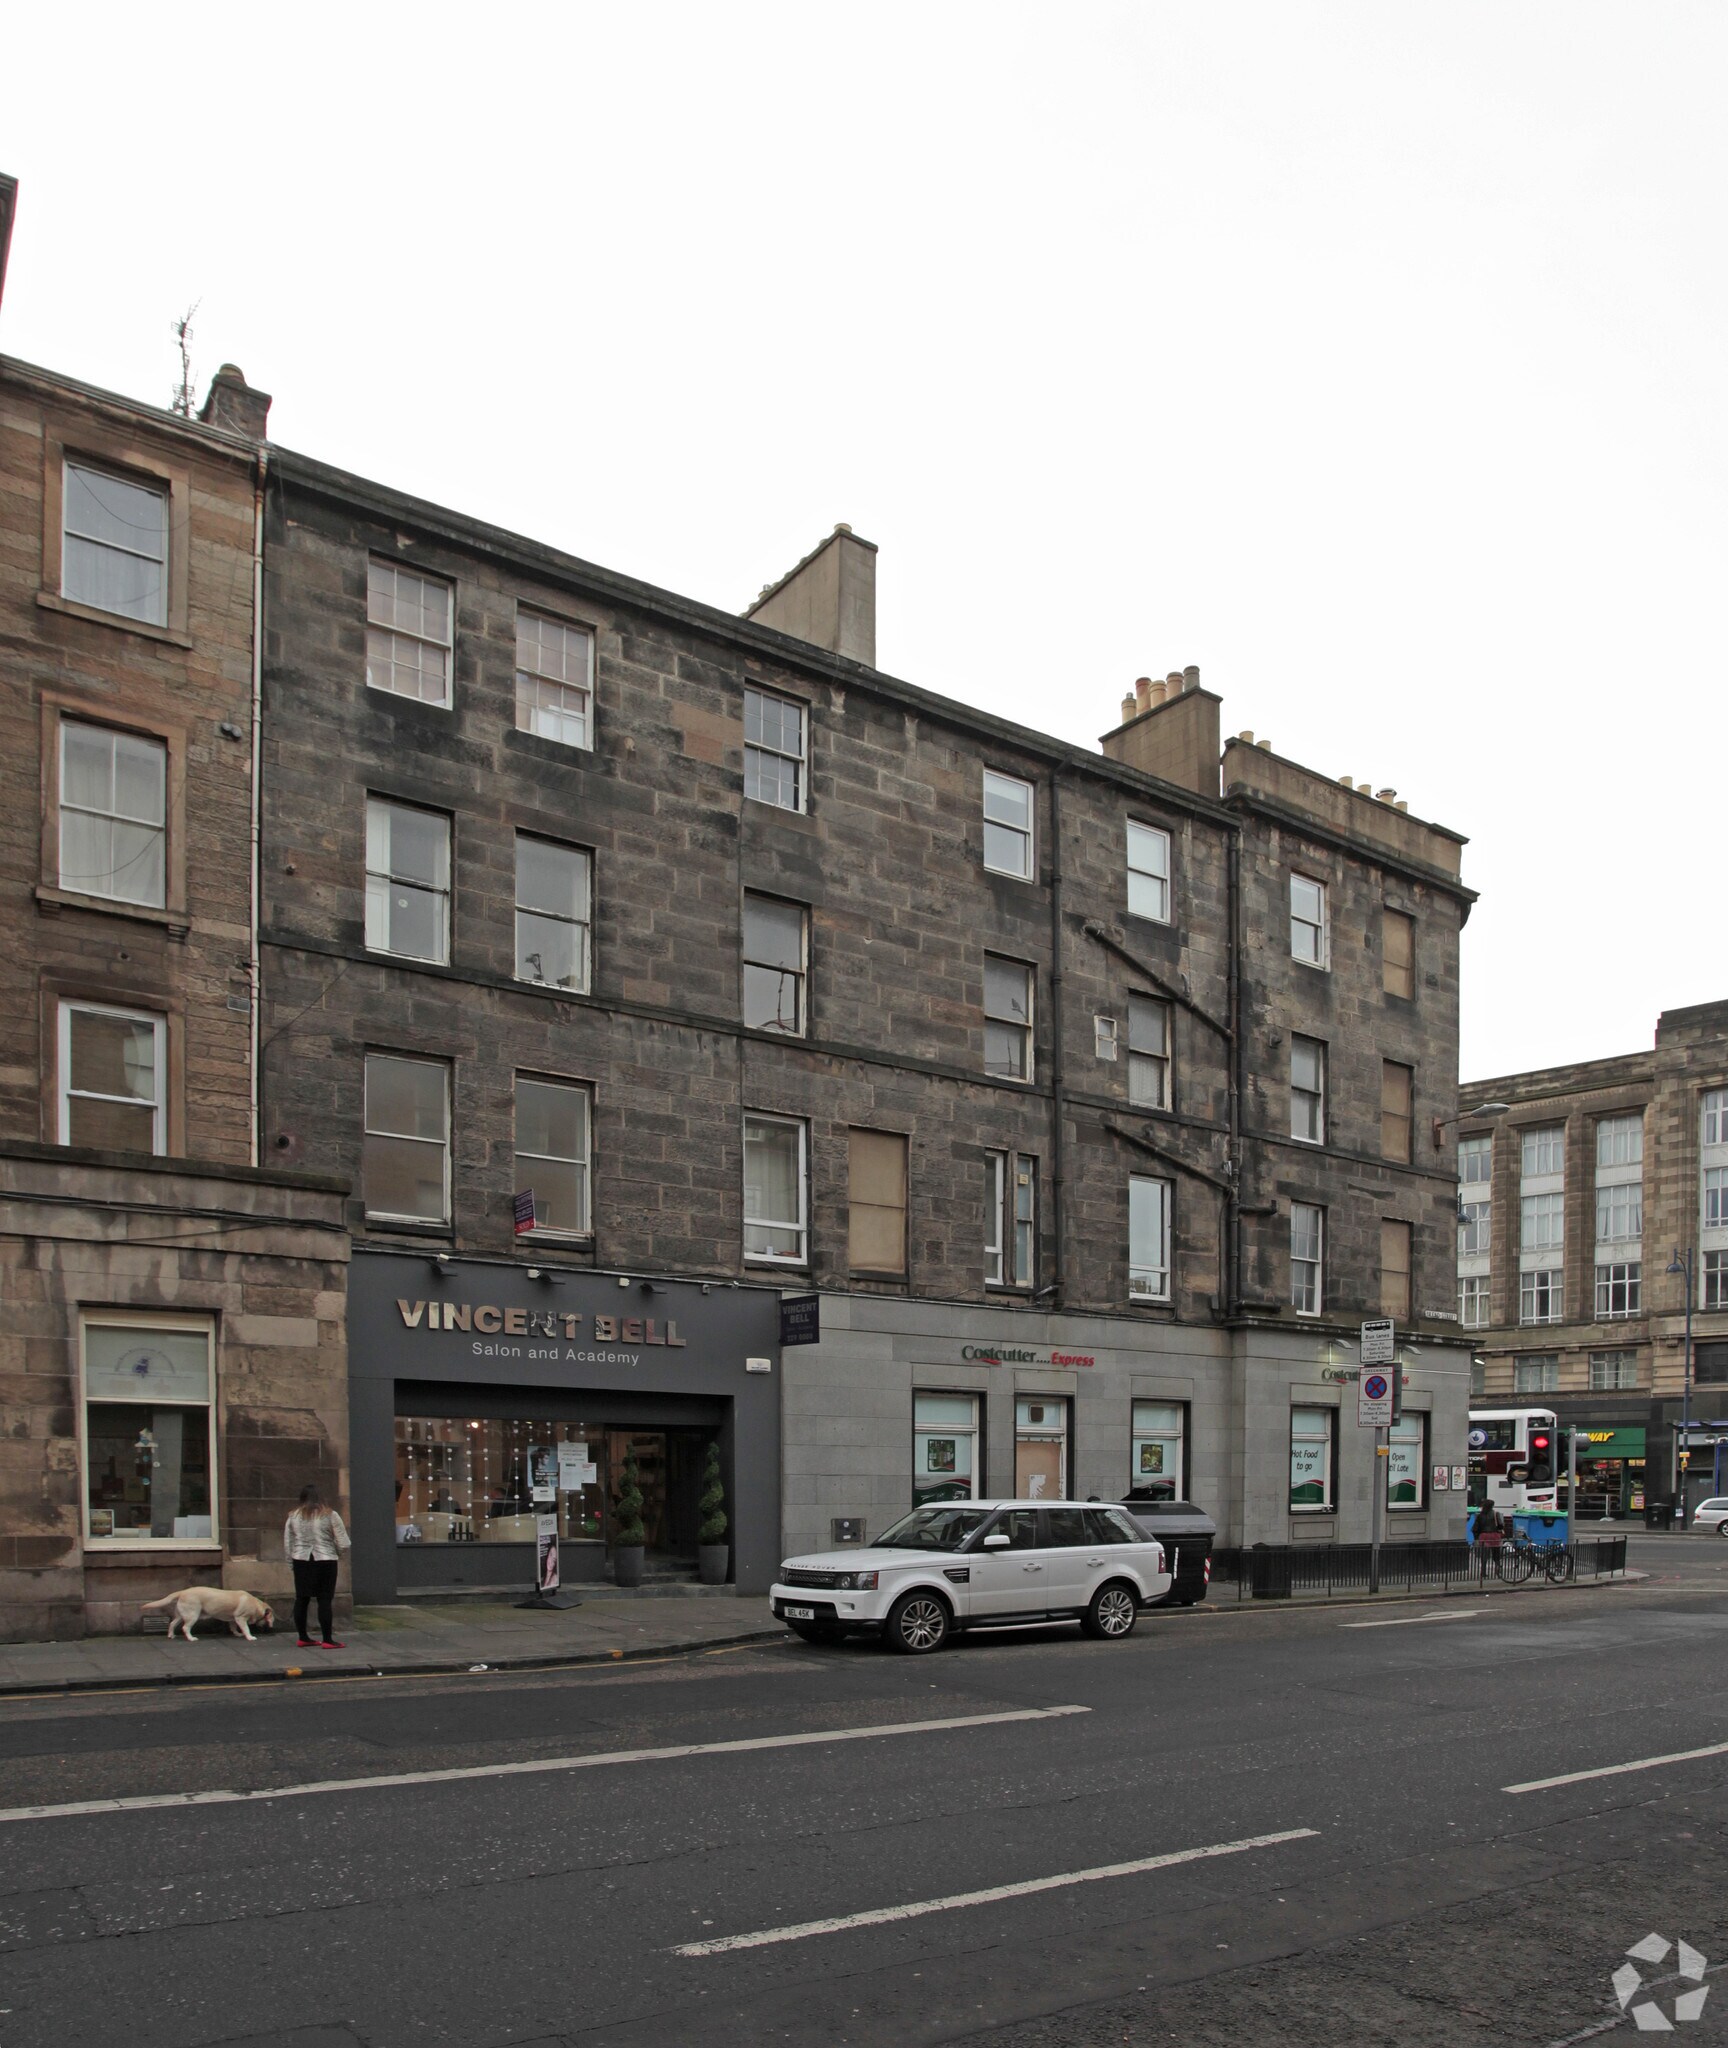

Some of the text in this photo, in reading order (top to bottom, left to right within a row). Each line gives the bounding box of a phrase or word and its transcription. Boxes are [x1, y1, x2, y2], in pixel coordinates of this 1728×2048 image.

[782, 1302, 817, 1315] VINCENT
[397, 1299, 687, 1347] VINCENT BELL
[789, 1314, 810, 1324] BELL
[472, 1341, 640, 1367] Salon and Academy
[1051, 1351, 1095, 1368] Express
[1292, 1450, 1319, 1459] Hot Food
[1391, 1452, 1406, 1463] Open
[1296, 1462, 1313, 1473] to go
[1396, 1464, 1409, 1473] Late
